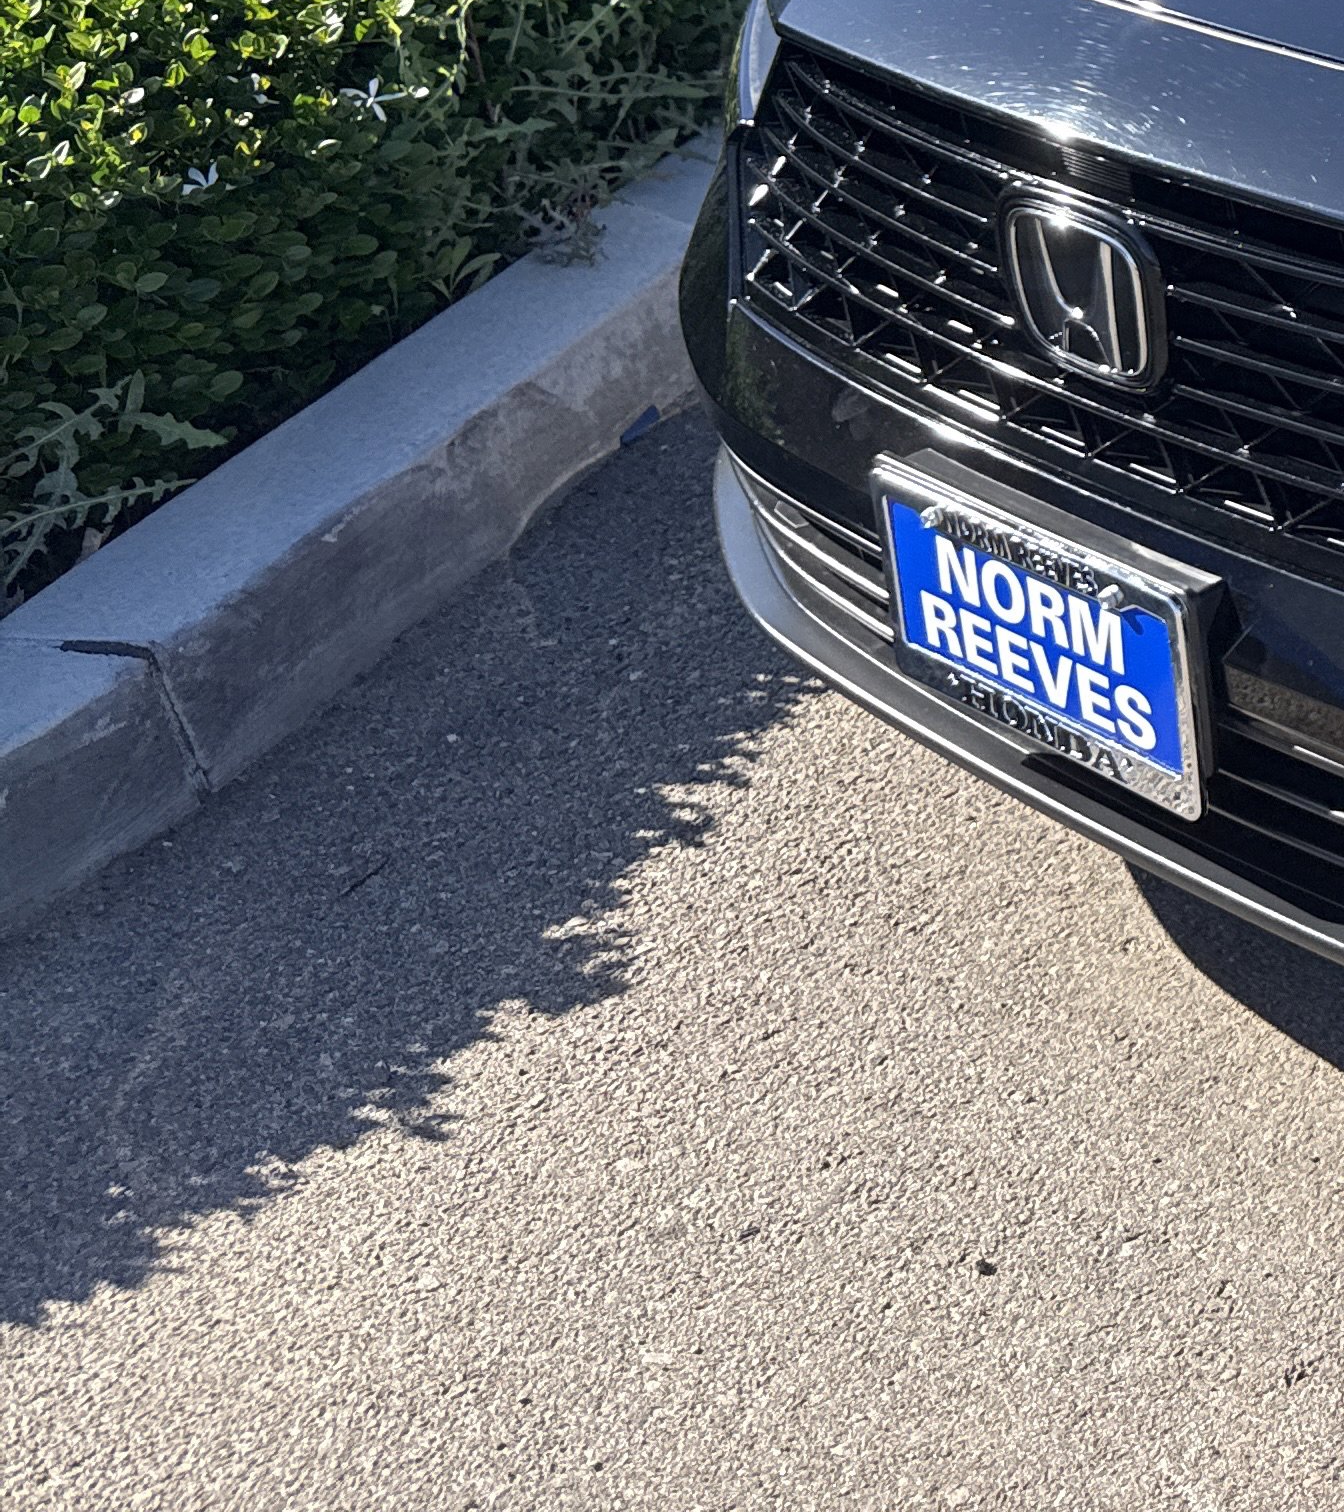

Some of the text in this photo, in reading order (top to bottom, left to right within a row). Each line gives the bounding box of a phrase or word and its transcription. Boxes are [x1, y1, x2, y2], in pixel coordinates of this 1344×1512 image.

[919, 589, 1158, 752] REEVES
[935, 534, 1126, 676] NORM
[960, 674, 1130, 785] HONDA
